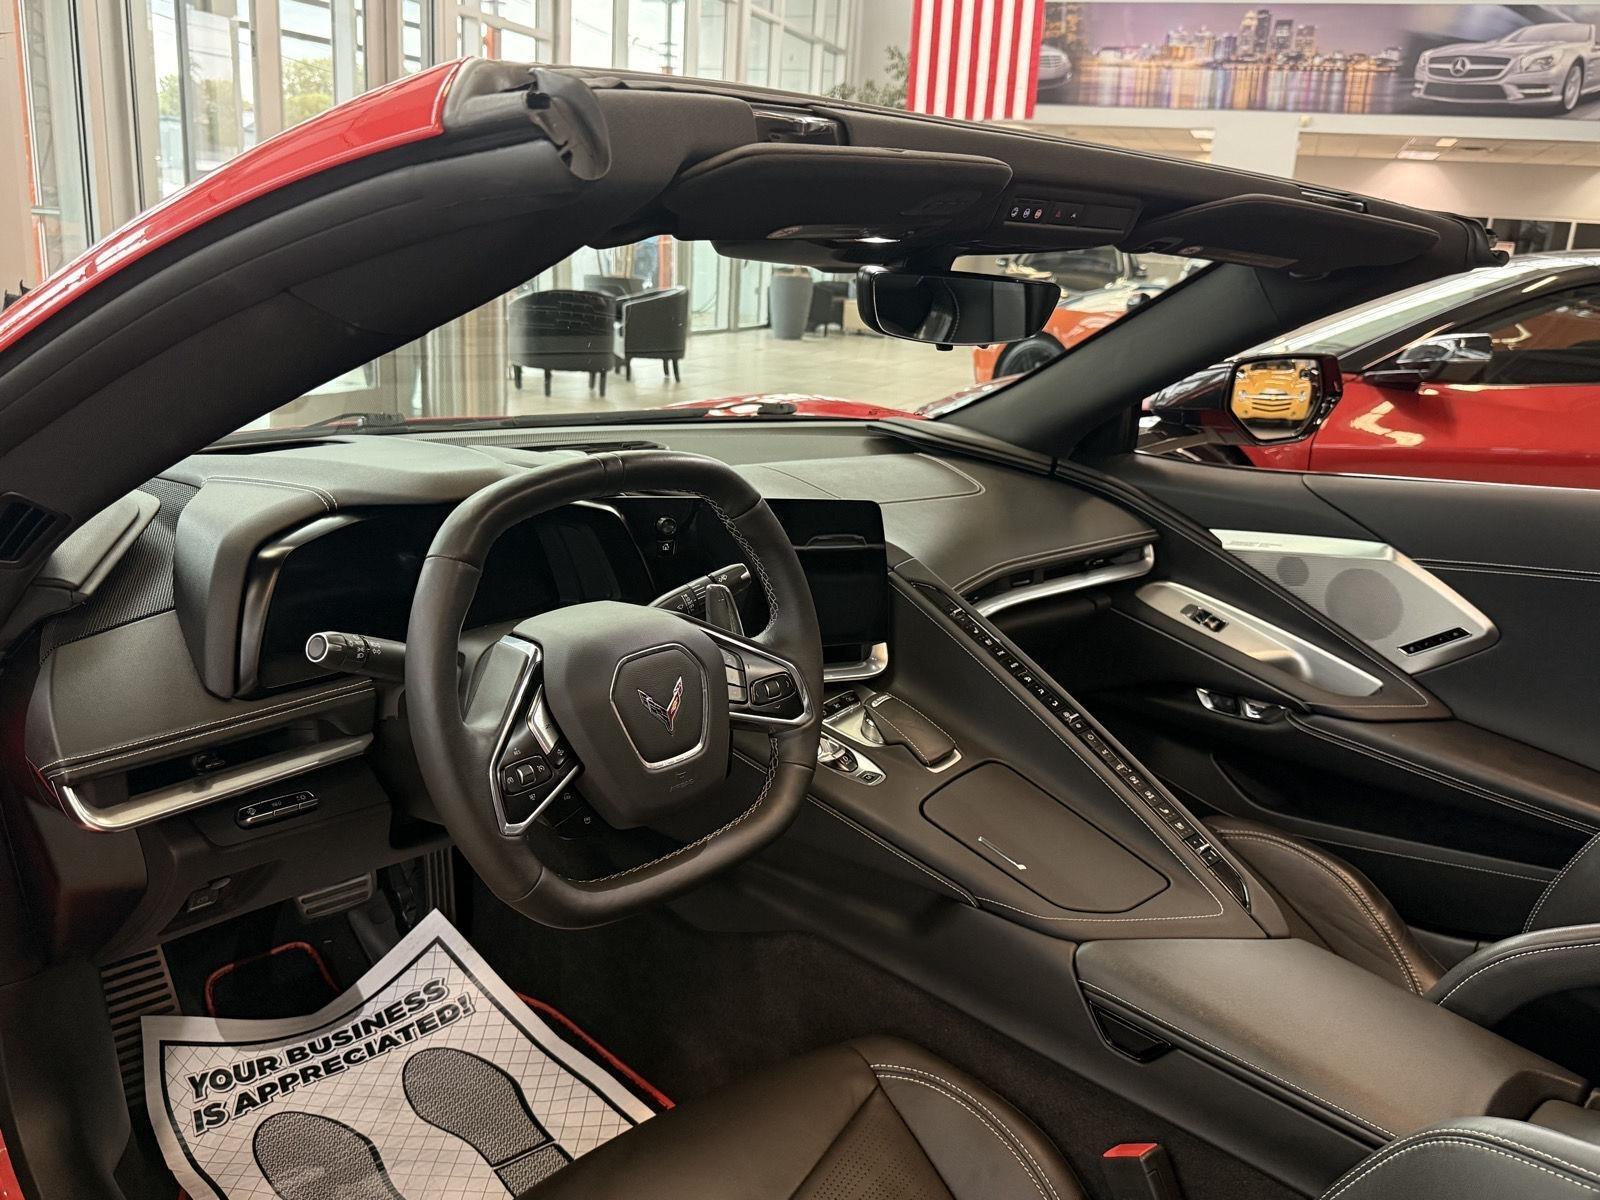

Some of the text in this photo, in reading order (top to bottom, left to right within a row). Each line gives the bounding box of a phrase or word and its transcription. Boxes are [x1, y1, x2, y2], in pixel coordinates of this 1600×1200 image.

[187, 978, 448, 1100] YOUR BUSINESS
[192, 992, 475, 1134] IS APPRECIATED!
